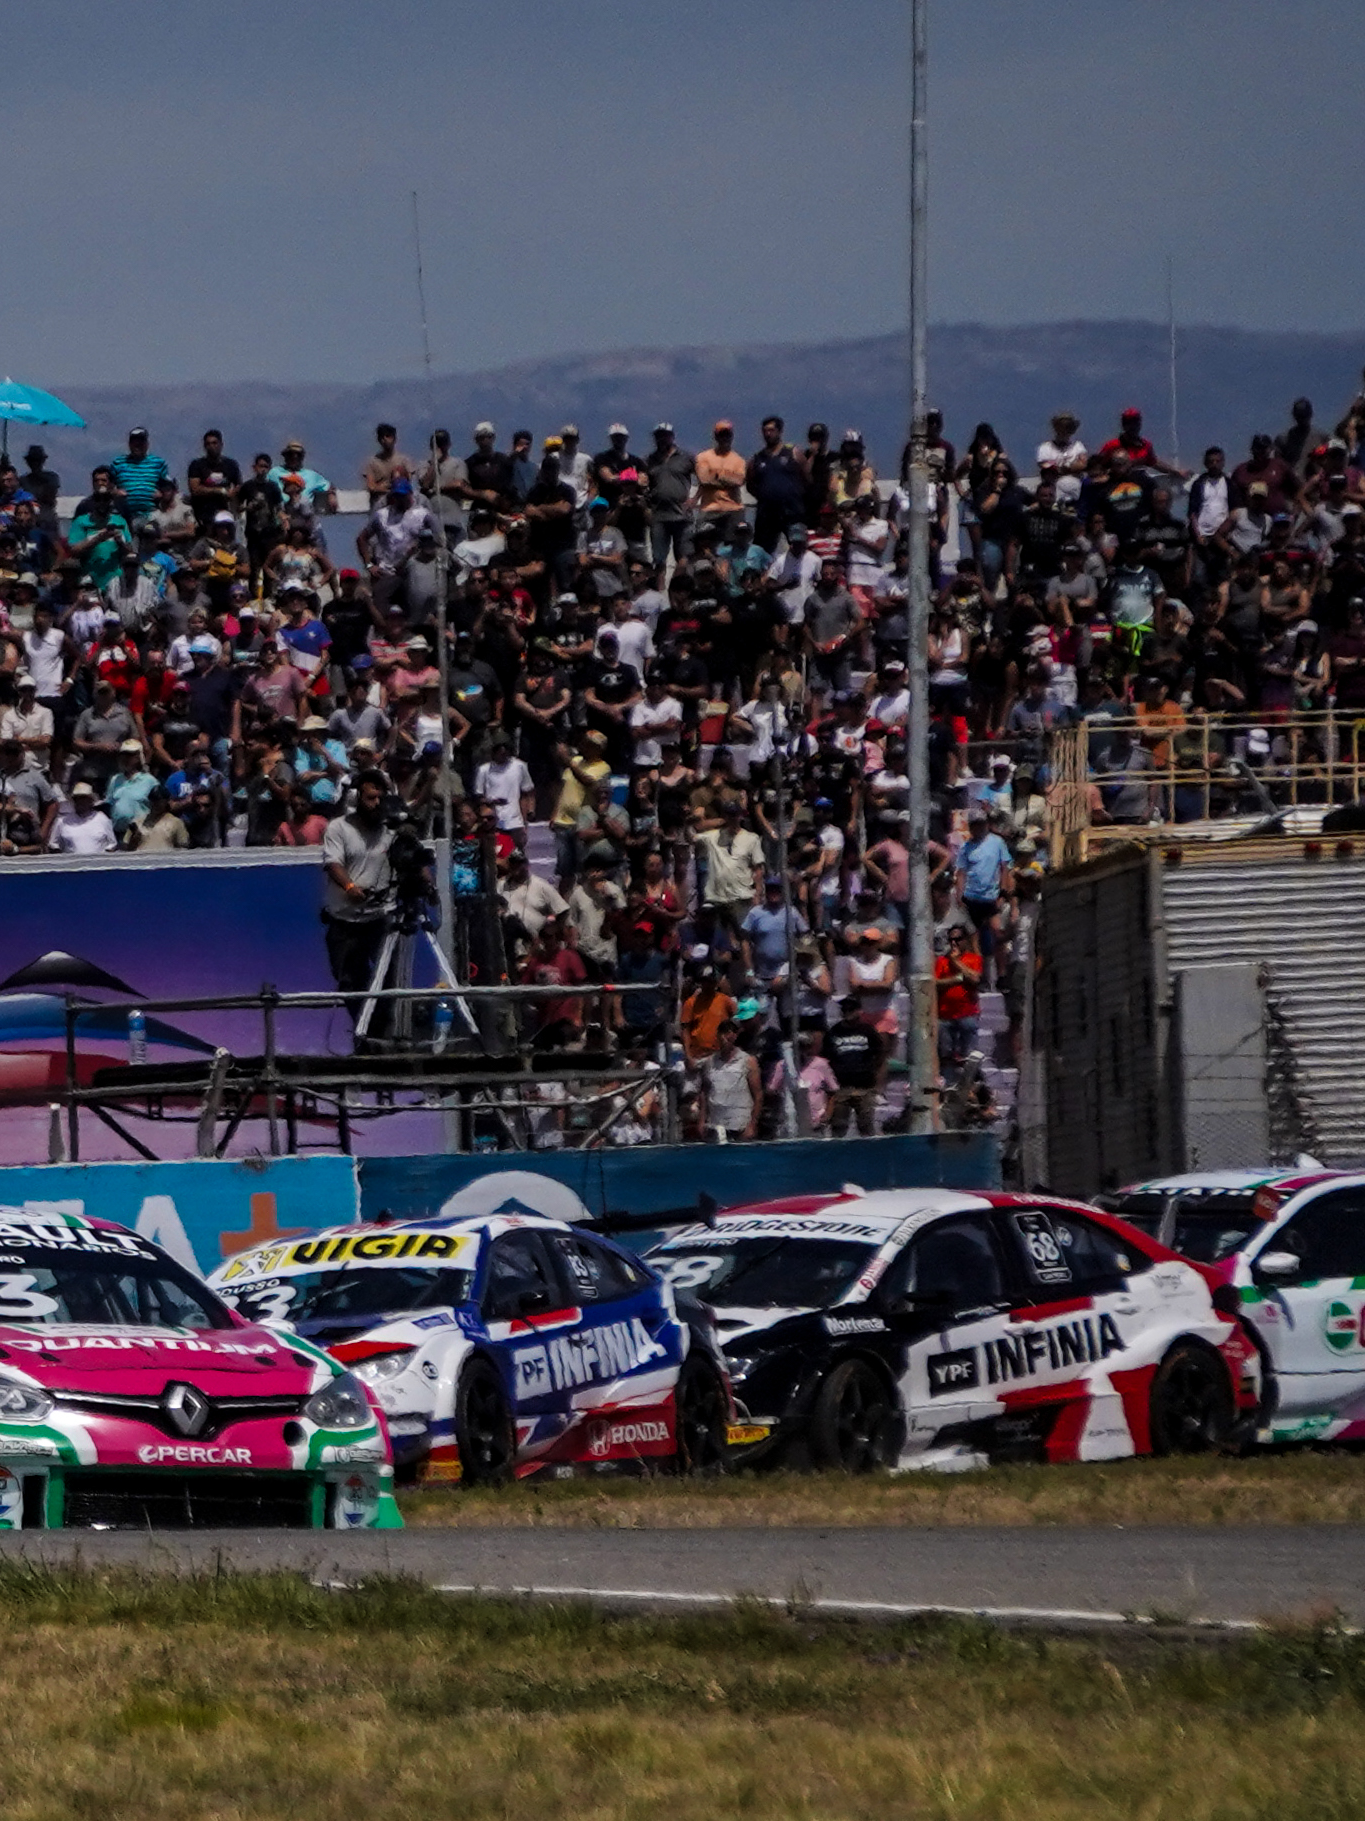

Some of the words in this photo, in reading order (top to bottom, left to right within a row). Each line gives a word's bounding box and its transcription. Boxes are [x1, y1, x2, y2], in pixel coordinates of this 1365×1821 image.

[549, 1316, 669, 1391] INFINIA
[935, 1361, 974, 1384] YPF
[988, 1312, 1130, 1385] INFINIA
[155, 1446, 253, 1465] PERCAR
[612, 1421, 670, 1444] HONDA
